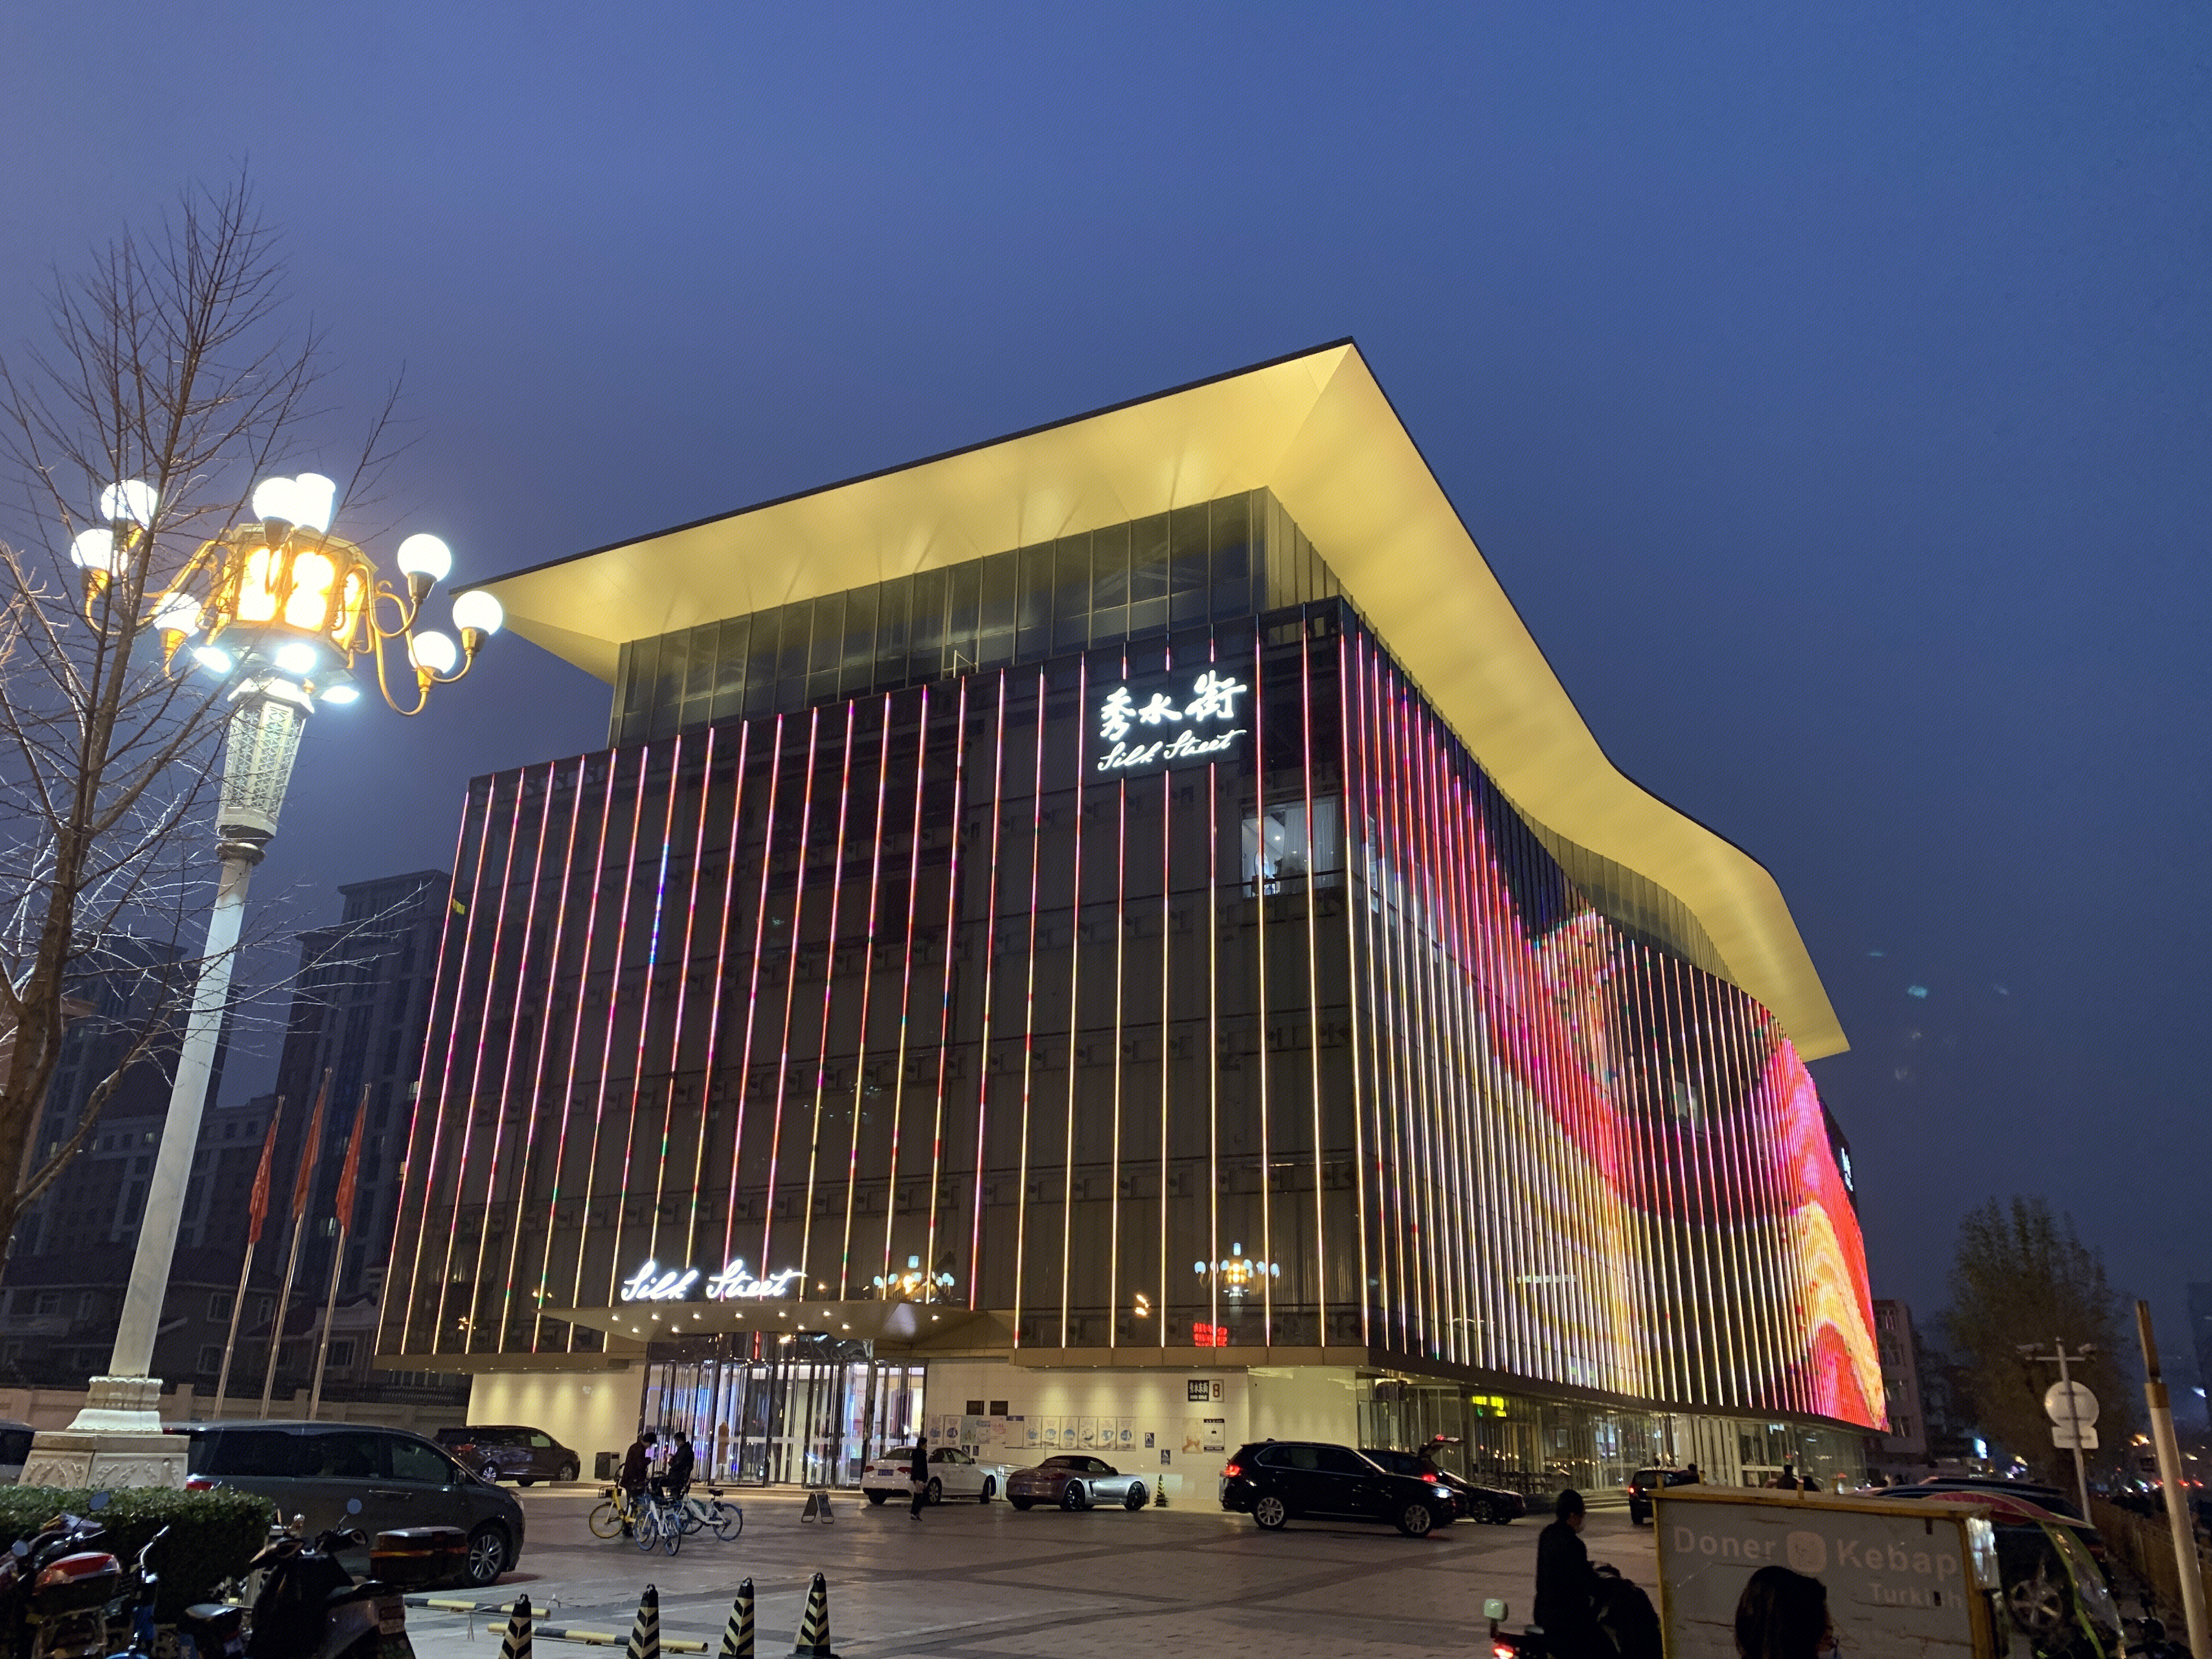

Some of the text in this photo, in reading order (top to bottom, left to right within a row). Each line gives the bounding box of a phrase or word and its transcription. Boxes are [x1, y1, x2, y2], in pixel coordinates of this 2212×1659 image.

[1099, 669, 1248, 741] 秀水街
[1097, 729, 1248, 771] Silk Street
[620, 1259, 808, 1301] Silk Street
[1213, 1384, 1220, 1397] 8
[1837, 1538, 1958, 1582] Kebap
